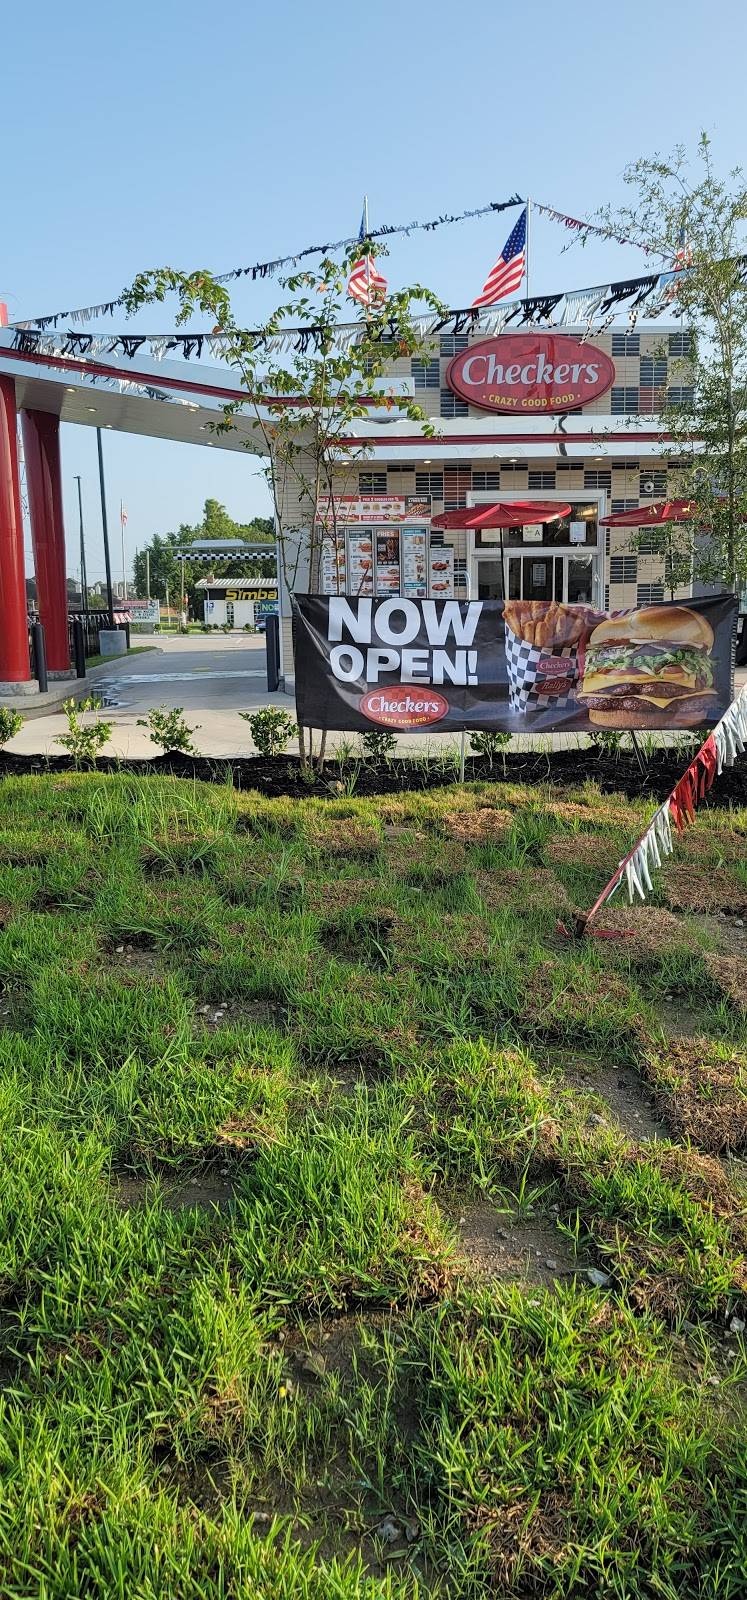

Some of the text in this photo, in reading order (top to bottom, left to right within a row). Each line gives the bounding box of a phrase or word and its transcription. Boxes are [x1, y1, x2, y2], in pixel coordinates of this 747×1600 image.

[462, 353, 600, 385] Checkers
[488, 393, 575, 407] CRAZY GOOD FOOD
[534, 529, 541, 537] A
[225, 588, 278, 601] Simba
[327, 596, 484, 647] NOW
[328, 644, 479, 686] OPEN!
[367, 695, 440, 713] Checkers
